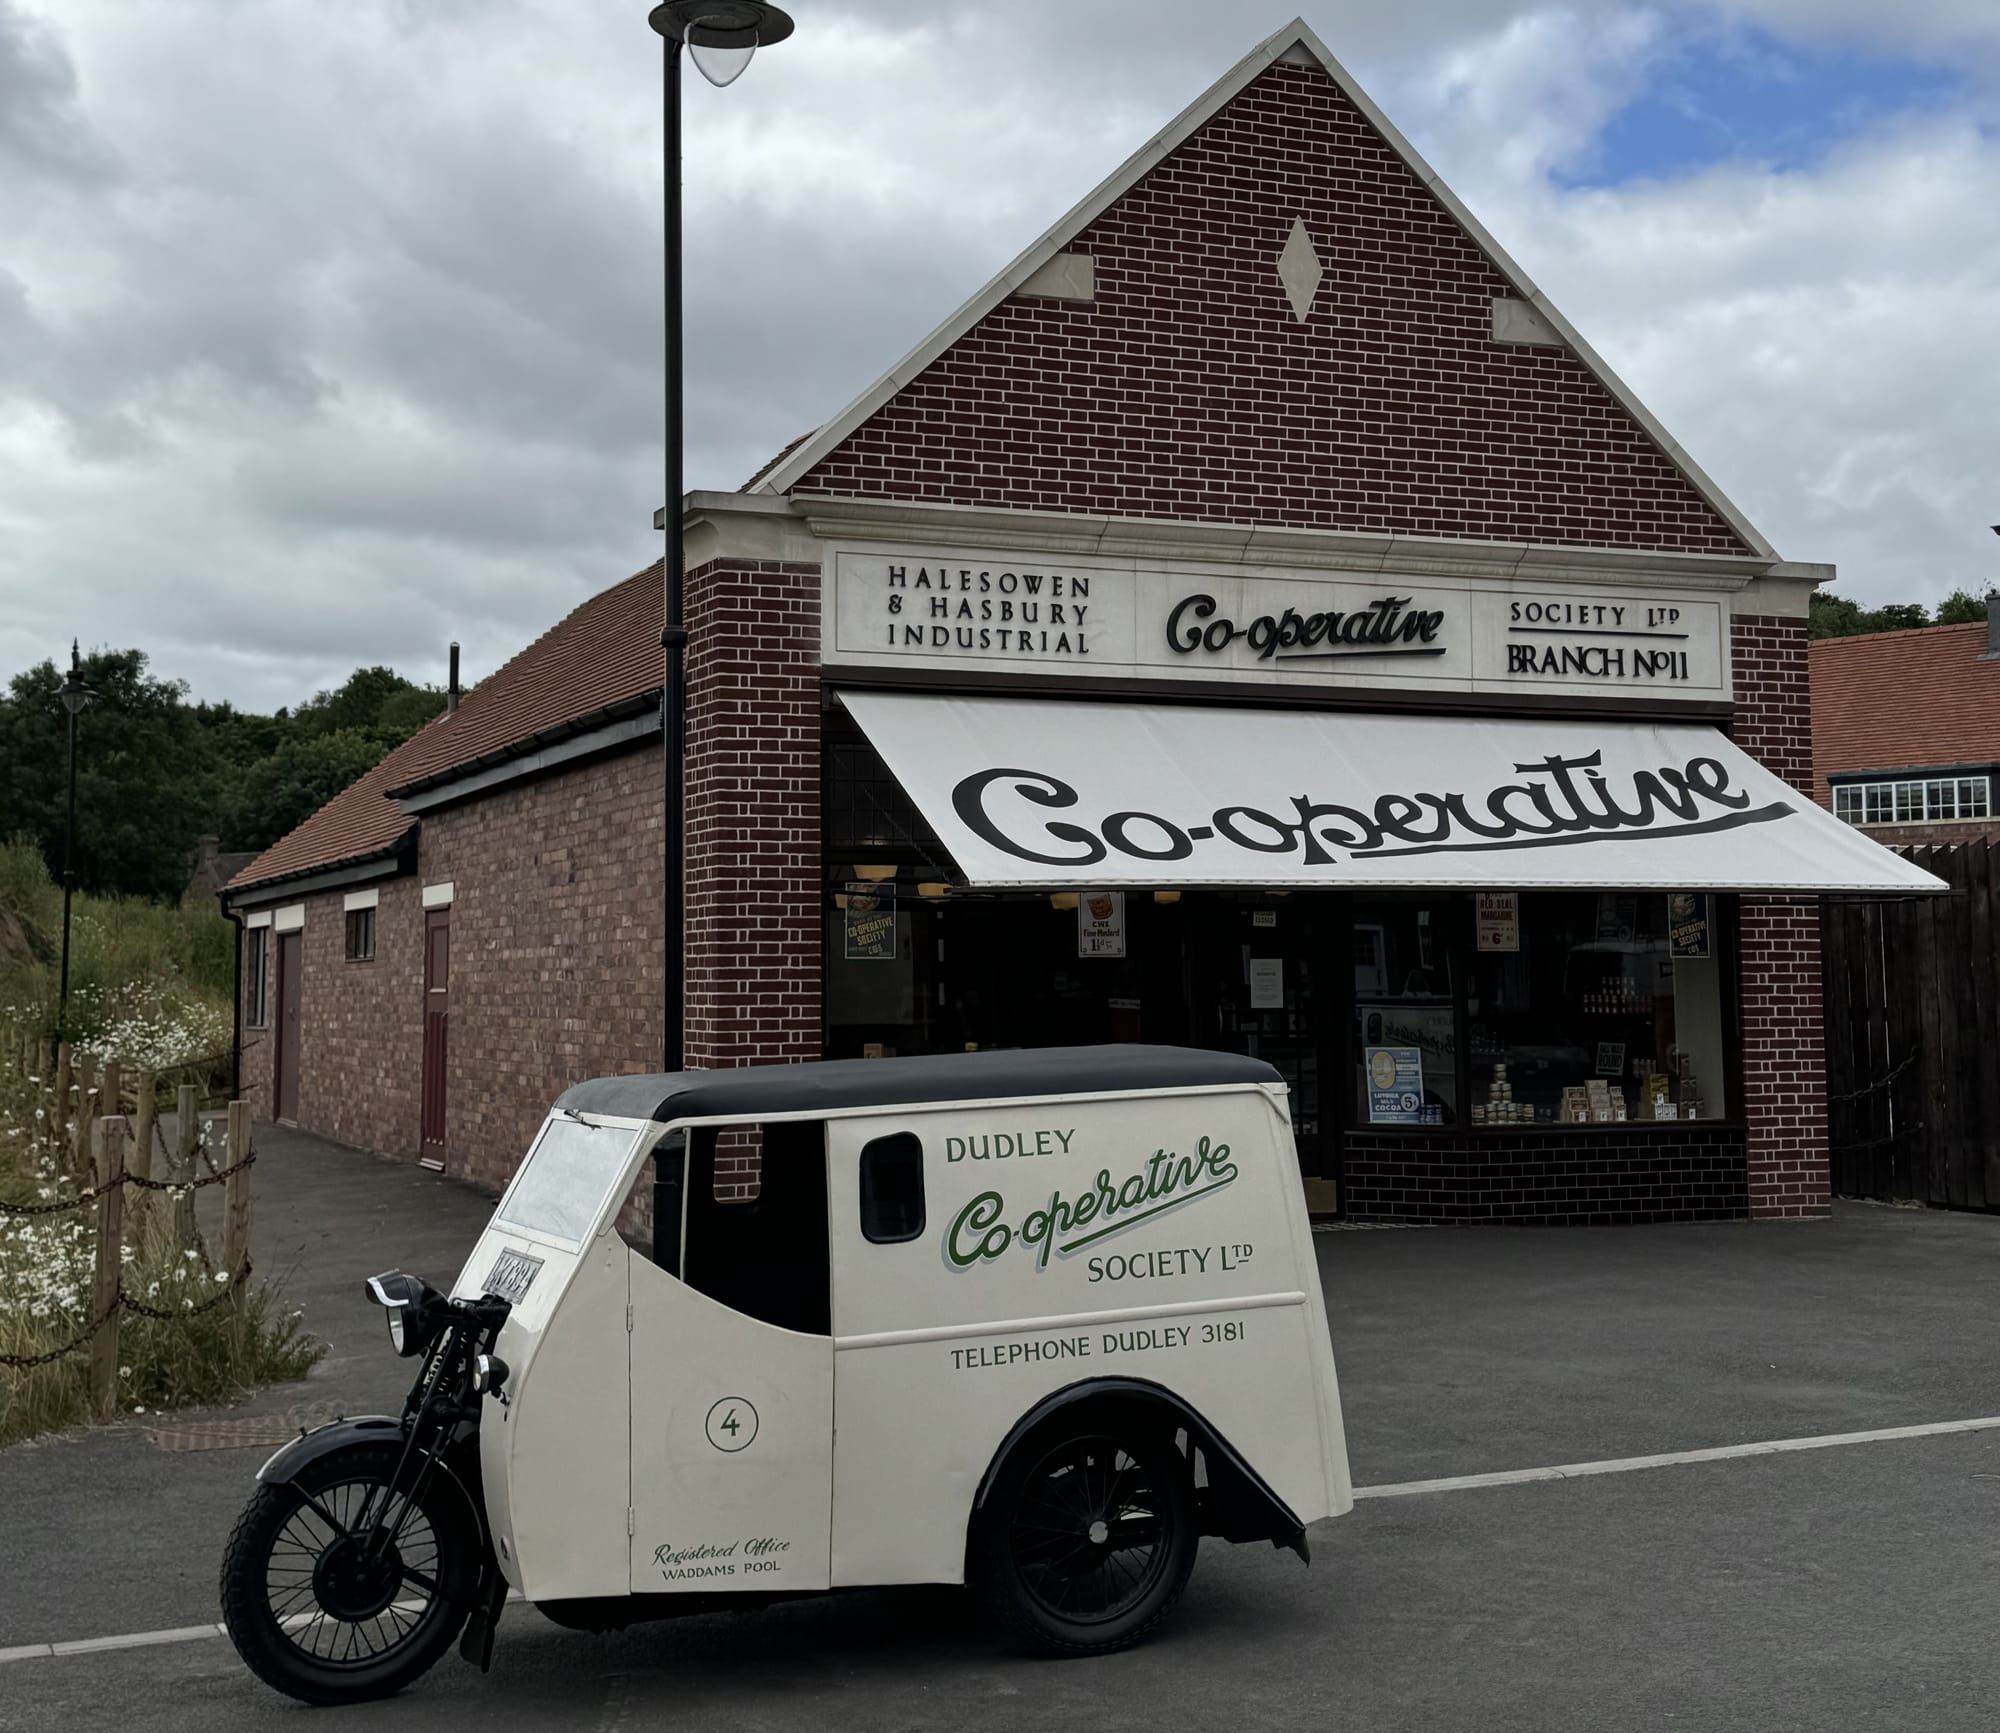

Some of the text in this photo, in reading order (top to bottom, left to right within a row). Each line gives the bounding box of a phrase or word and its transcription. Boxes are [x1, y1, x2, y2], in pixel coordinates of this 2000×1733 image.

[888, 565, 1090, 598] HALESOWEN
[888, 595, 1089, 626] & HASBURY
[1510, 602, 1626, 626] SOCIETY
[888, 624, 1090, 654] INDUSTRIAL
[1166, 594, 1446, 661] Co-operative
[1507, 645, 1626, 677] BRANCH
[951, 749, 1798, 867] Co-operative
[945, 1129, 1076, 1163] DUDLEY
[941, 1135, 1239, 1273] Co-operative
[1087, 1247, 1212, 1282] SOCIETY
[951, 1321, 1246, 1370] TELEPHONE DUDLEY 3181
[720, 1408, 741, 1437] 4
[652, 1537, 791, 1566] Registered Office
[662, 1561, 781, 1581] WADDAMS POOL
